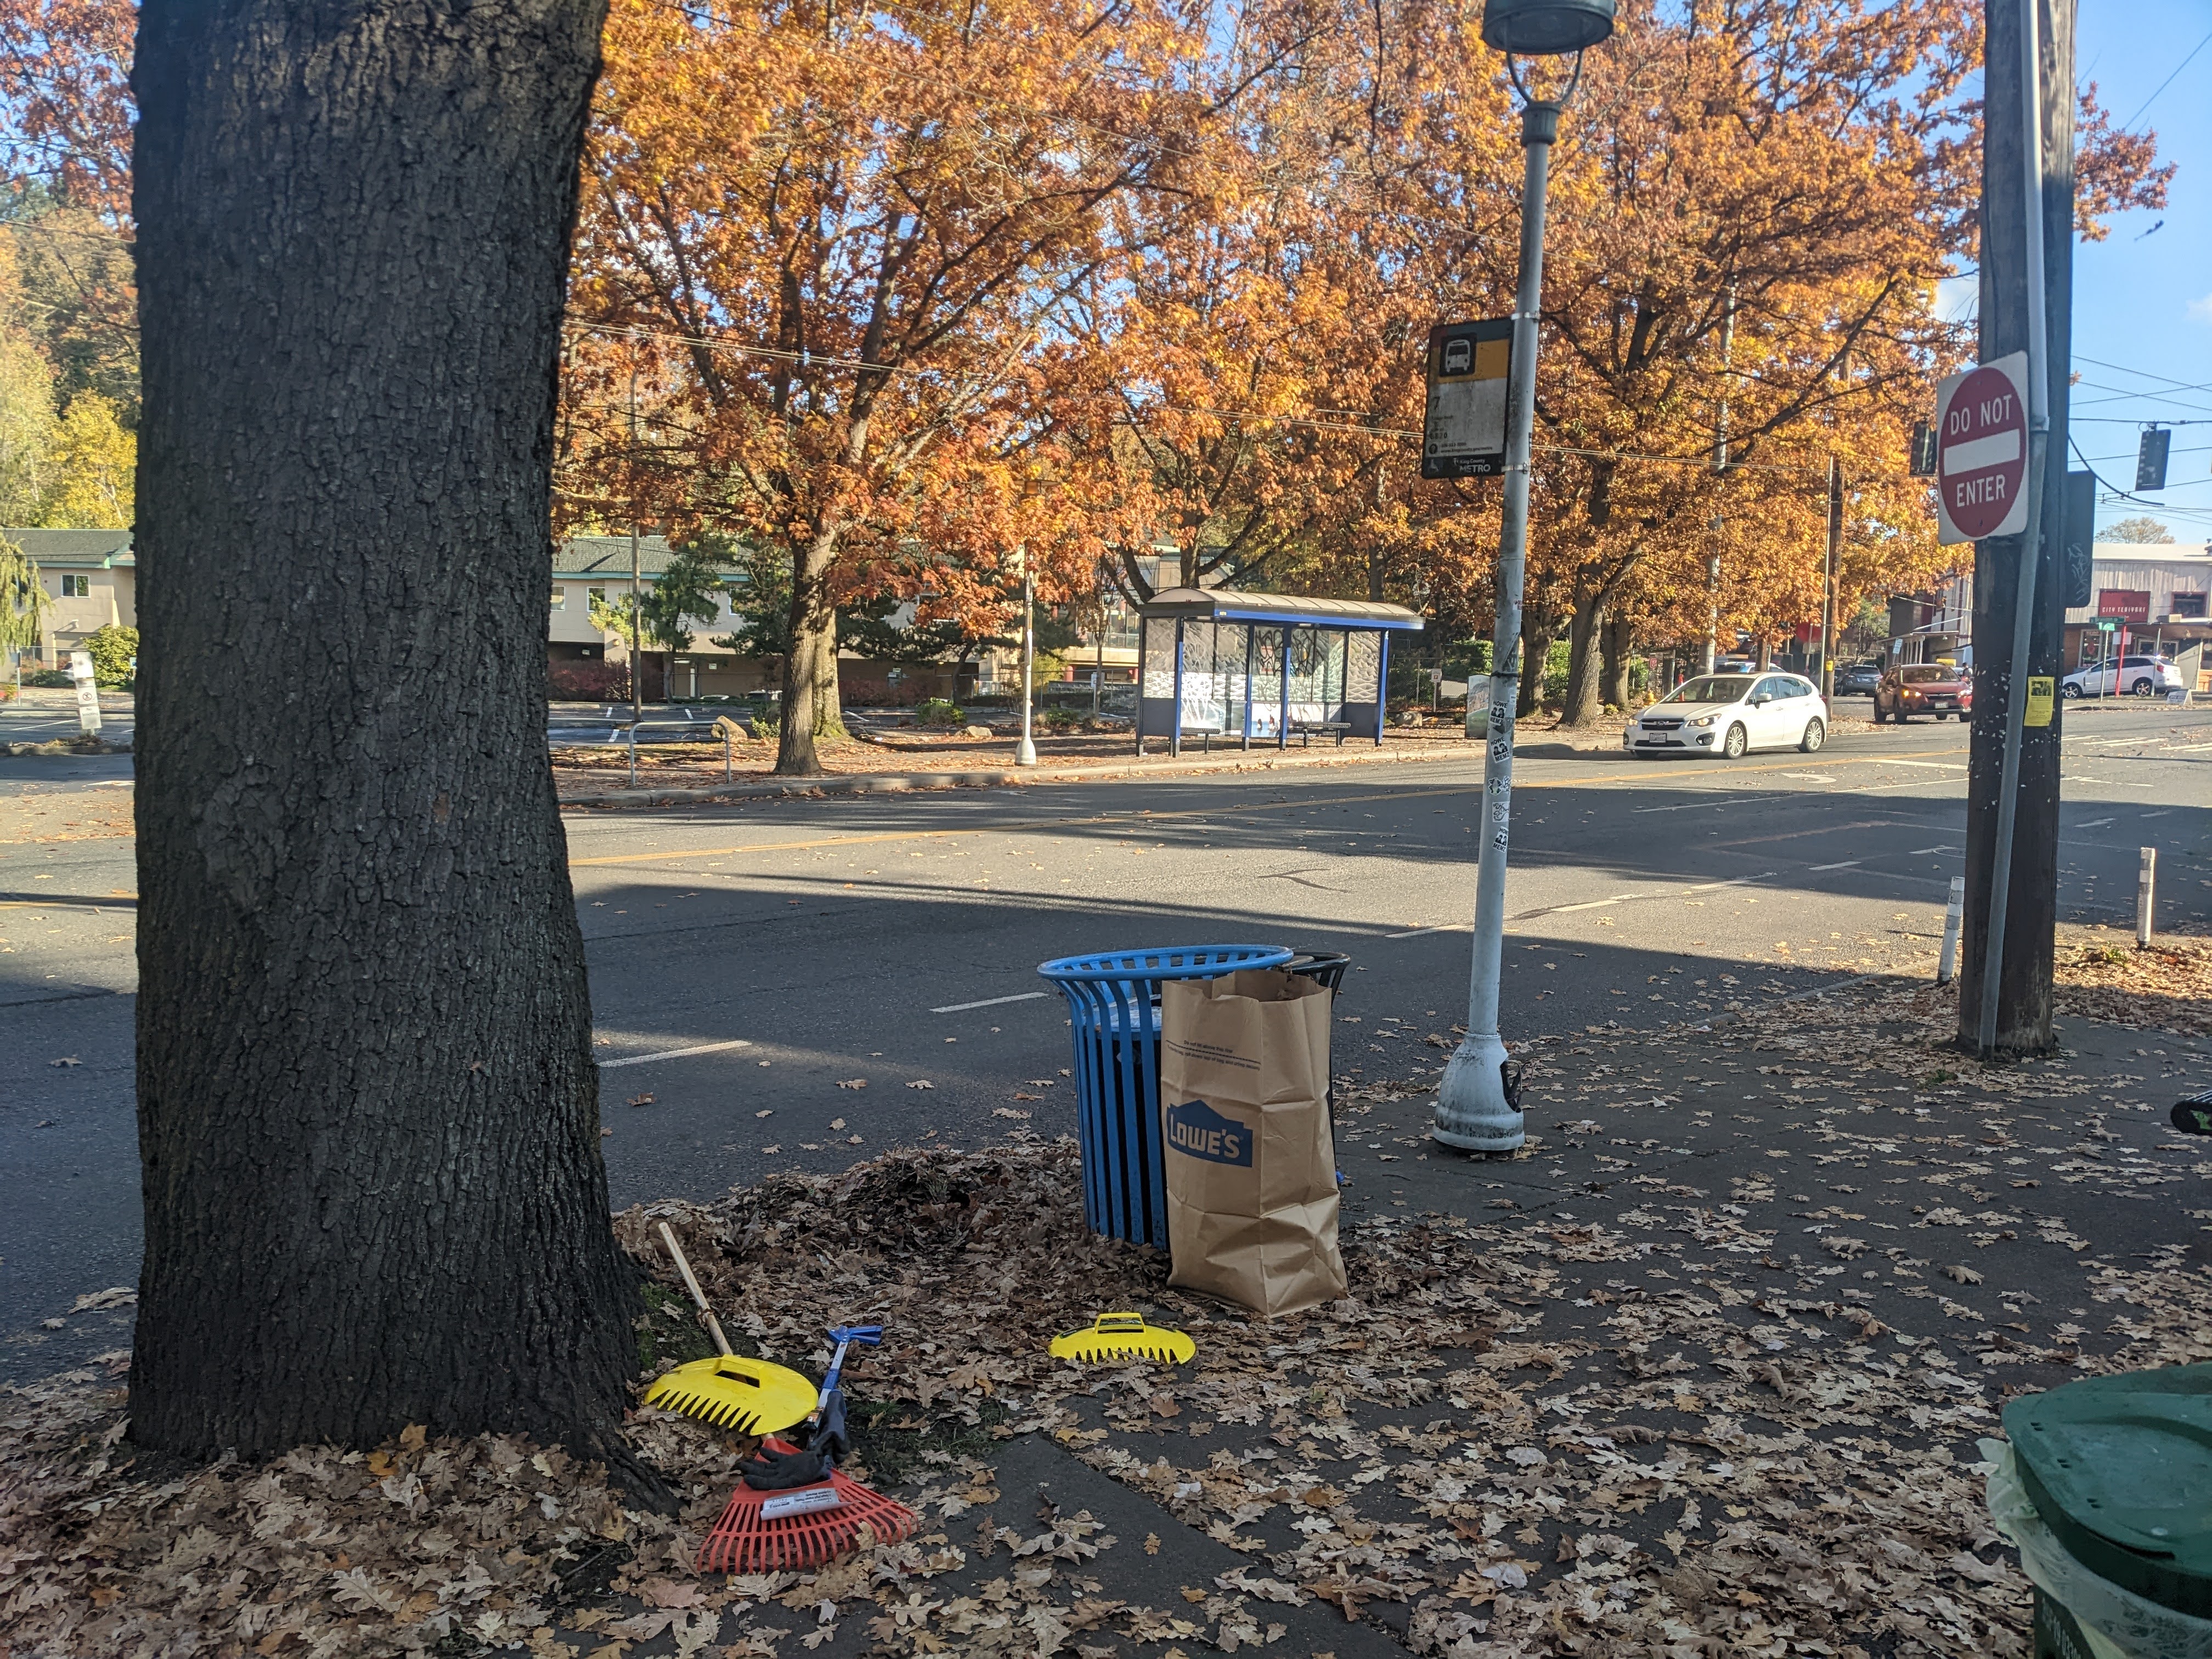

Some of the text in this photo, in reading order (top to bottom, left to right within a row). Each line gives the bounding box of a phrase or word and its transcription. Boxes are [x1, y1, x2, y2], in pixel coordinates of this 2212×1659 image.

[1950, 393, 2012, 436] DO NOT
[1459, 464, 1491, 473] METRO
[1956, 473, 2006, 508] ENTER
[1169, 1113, 1241, 1159] LOWE'S
